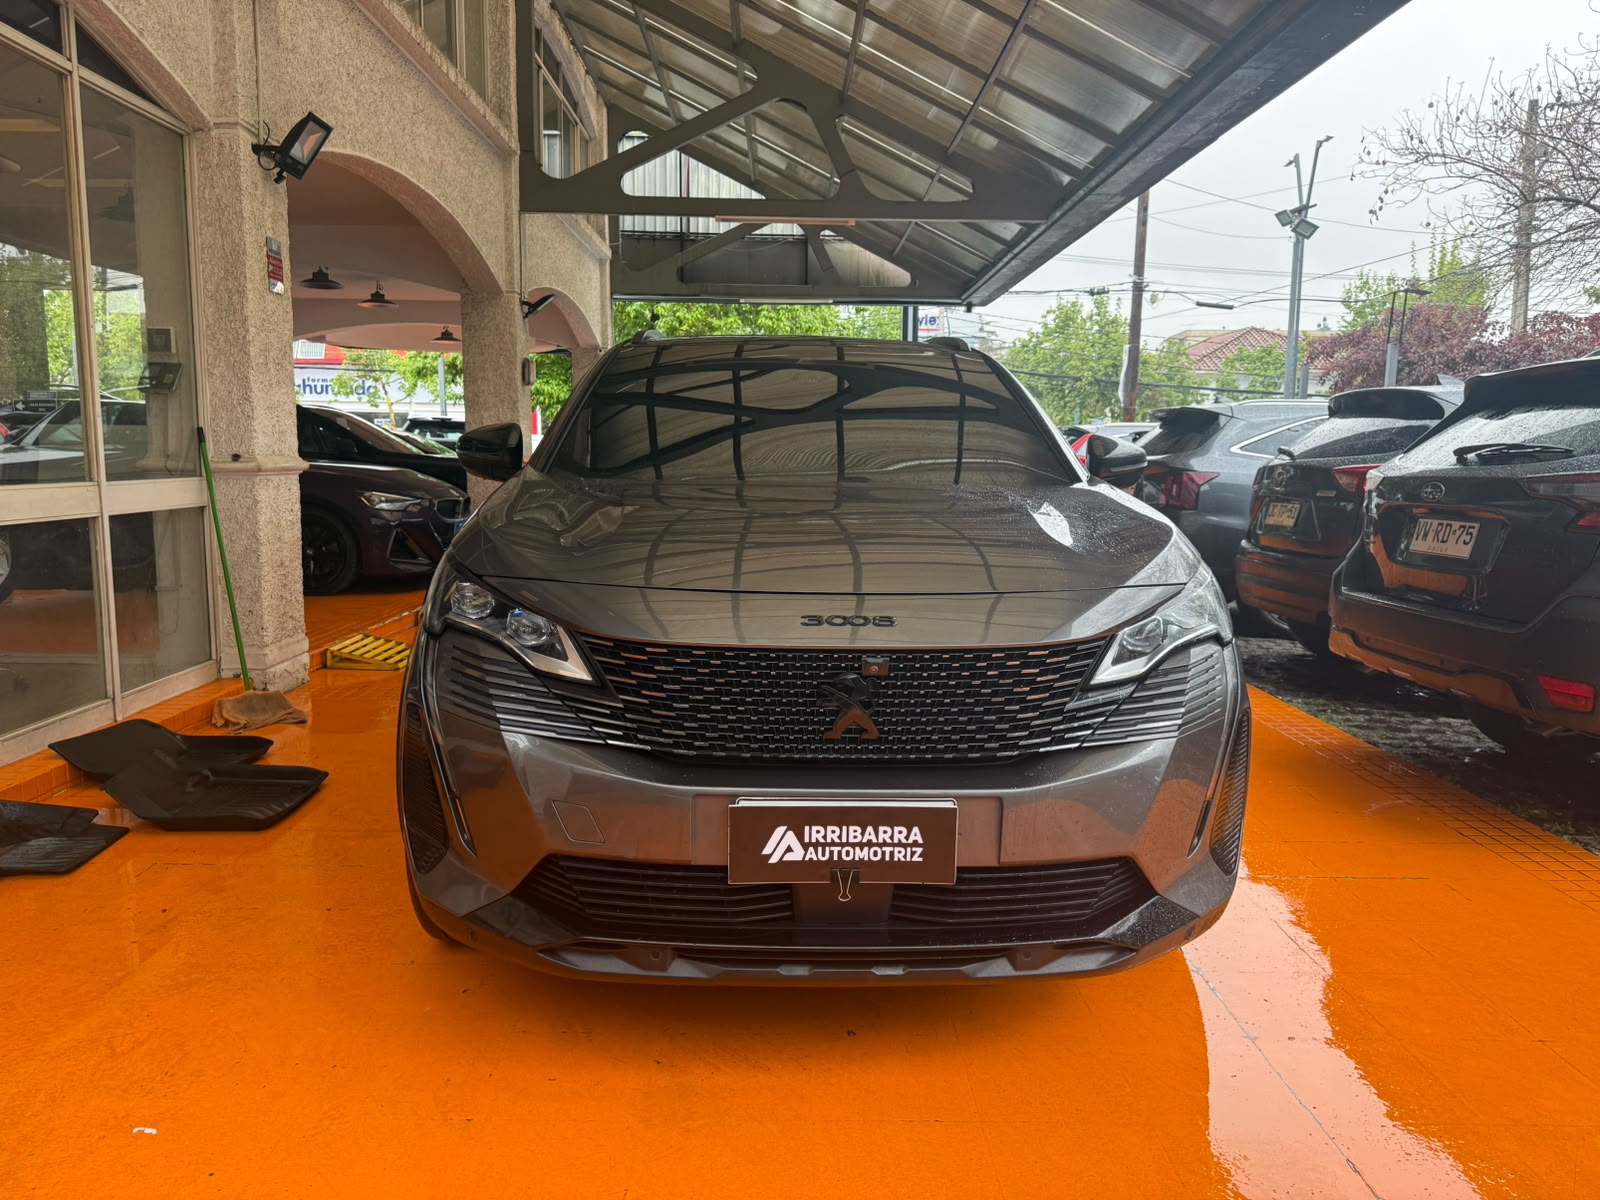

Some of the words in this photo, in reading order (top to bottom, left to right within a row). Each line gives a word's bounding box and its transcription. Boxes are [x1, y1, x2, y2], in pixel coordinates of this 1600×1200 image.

[800, 615, 897, 627] 3008
[804, 825, 923, 844] IRRIBARRA
[805, 847, 923, 862] AUTOMOTRIZ
